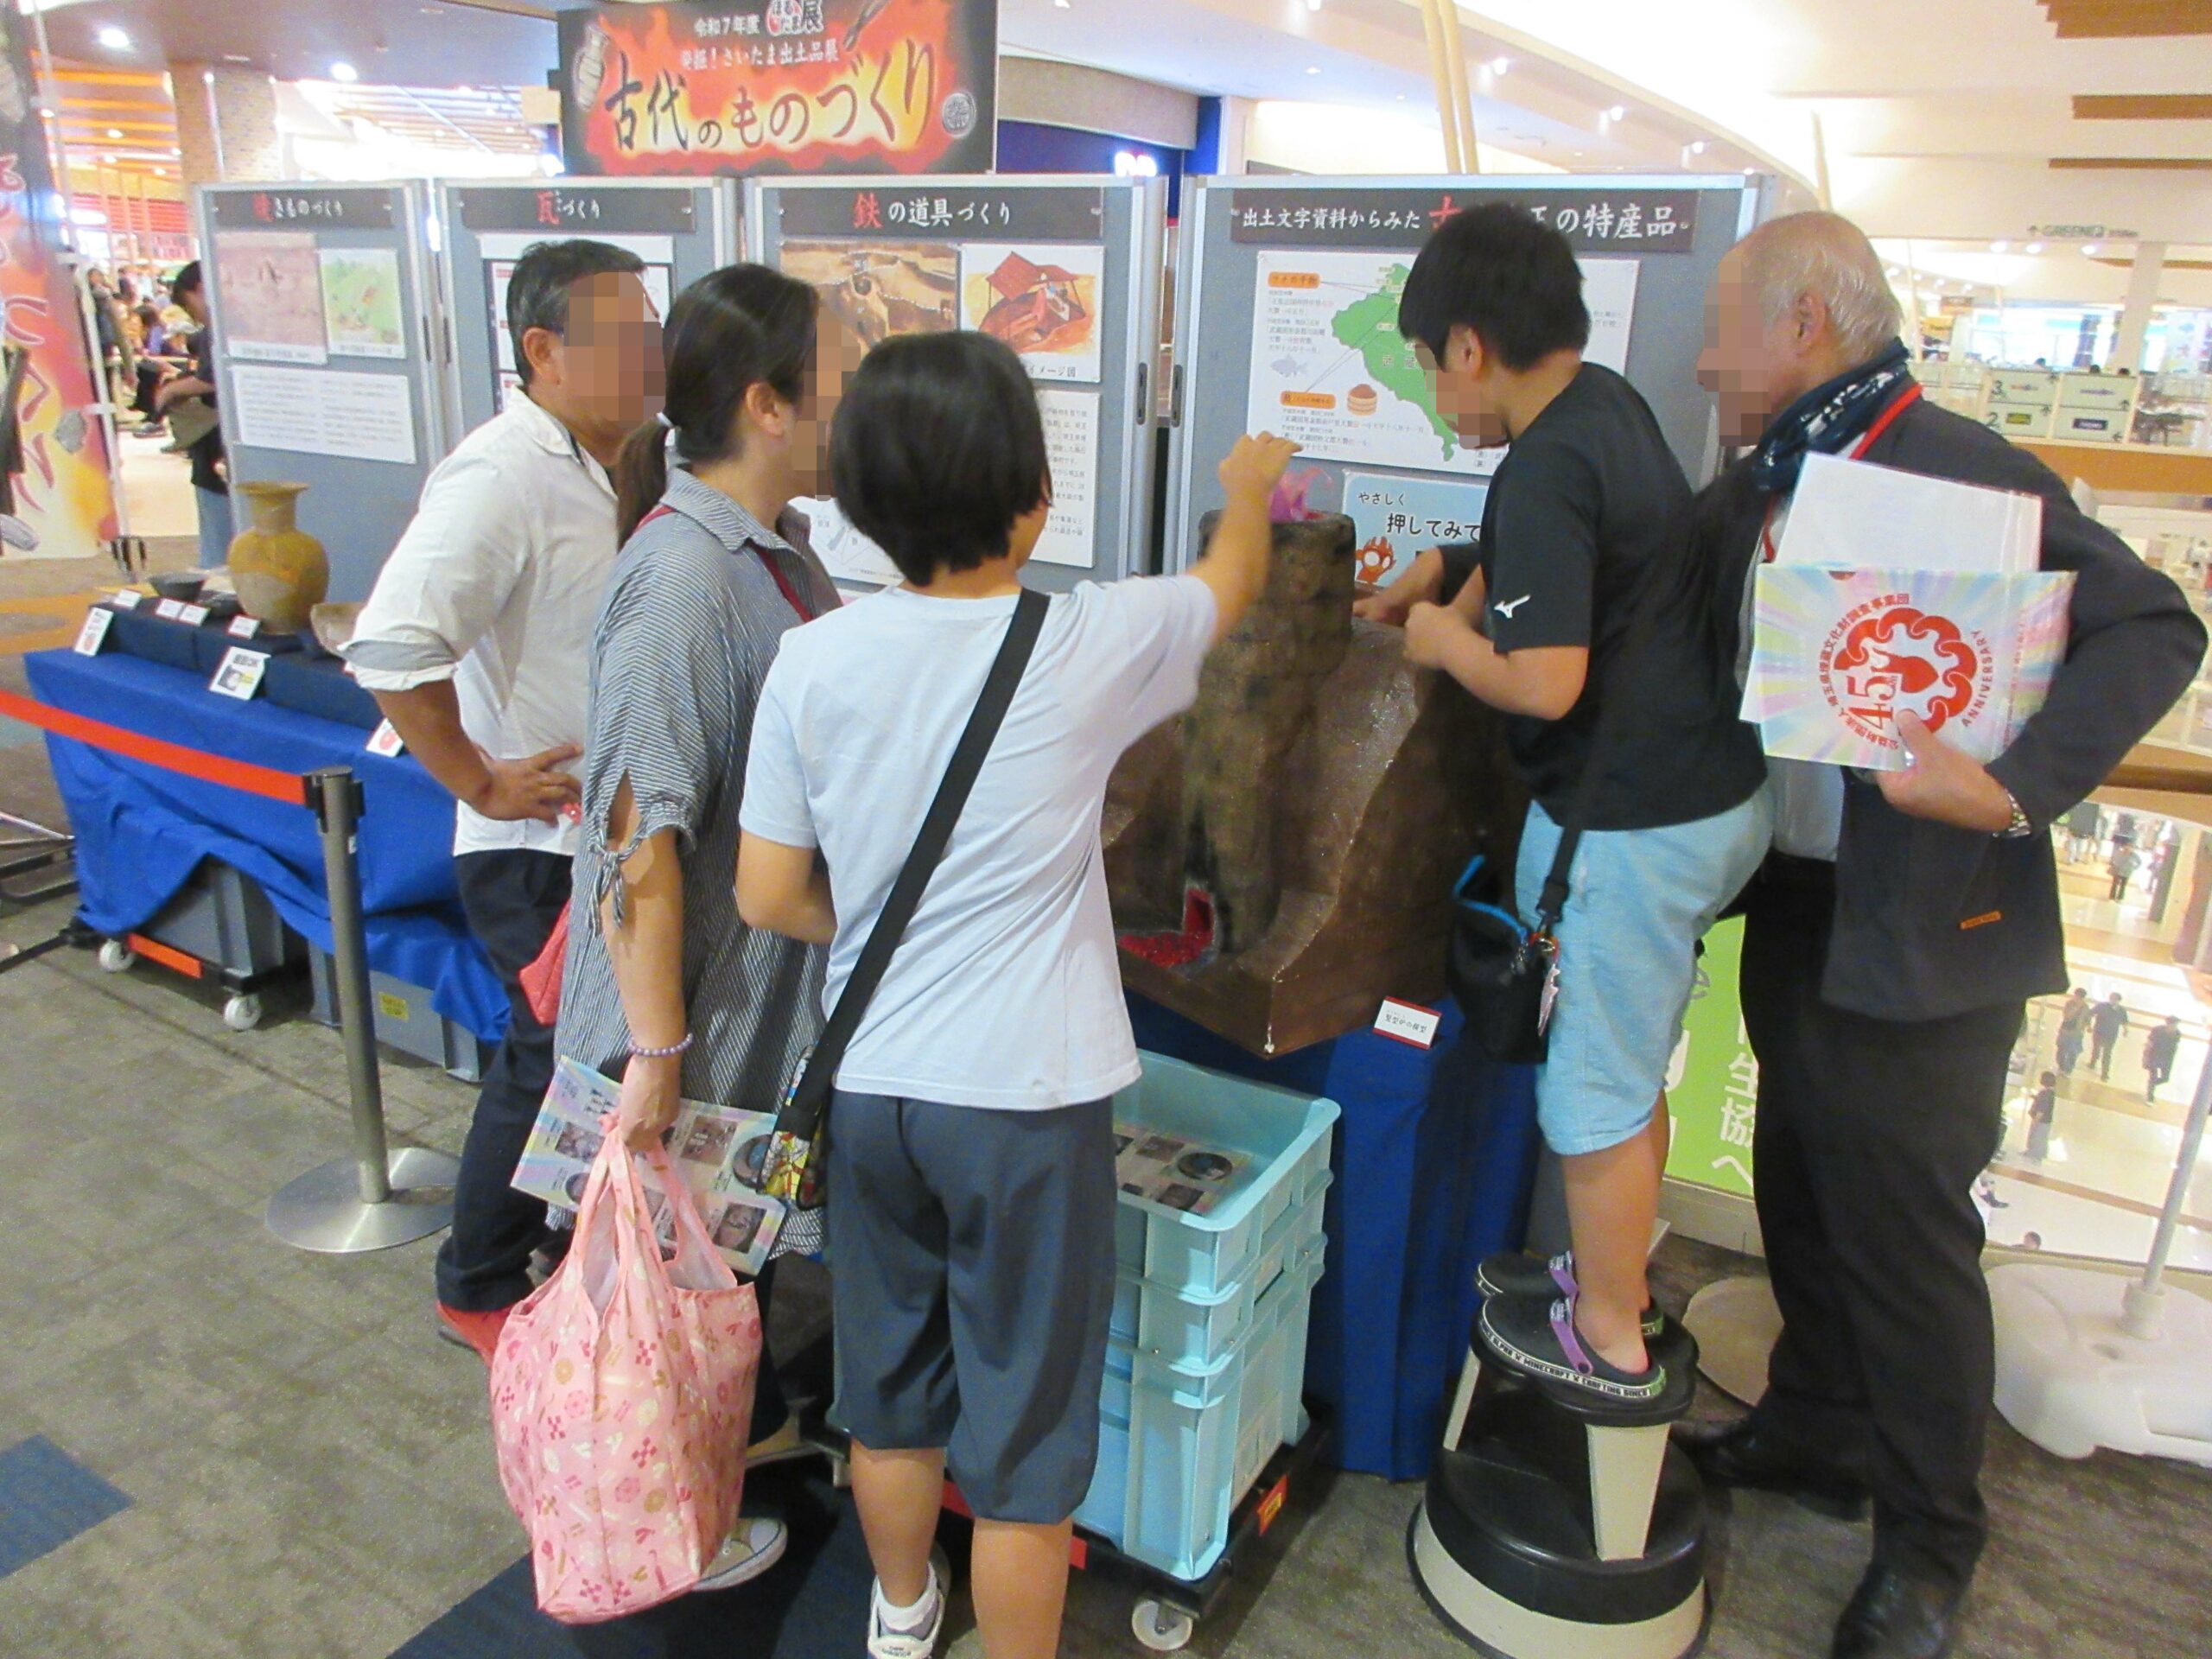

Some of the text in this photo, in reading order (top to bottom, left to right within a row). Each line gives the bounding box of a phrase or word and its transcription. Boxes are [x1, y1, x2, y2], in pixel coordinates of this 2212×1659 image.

[605, 38, 936, 151] 古代のものづくり
[853, 192, 1010, 229] 鉄の道具づくり
[1242, 207, 1421, 230] 出土文字資料からみた
[1358, 492, 1406, 506] やさしく
[1386, 512, 1481, 542] 押してみて
[1961, 629, 1993, 728] ANNIVERSARY
[1523, 1357, 1570, 1379] MINECRAFT
